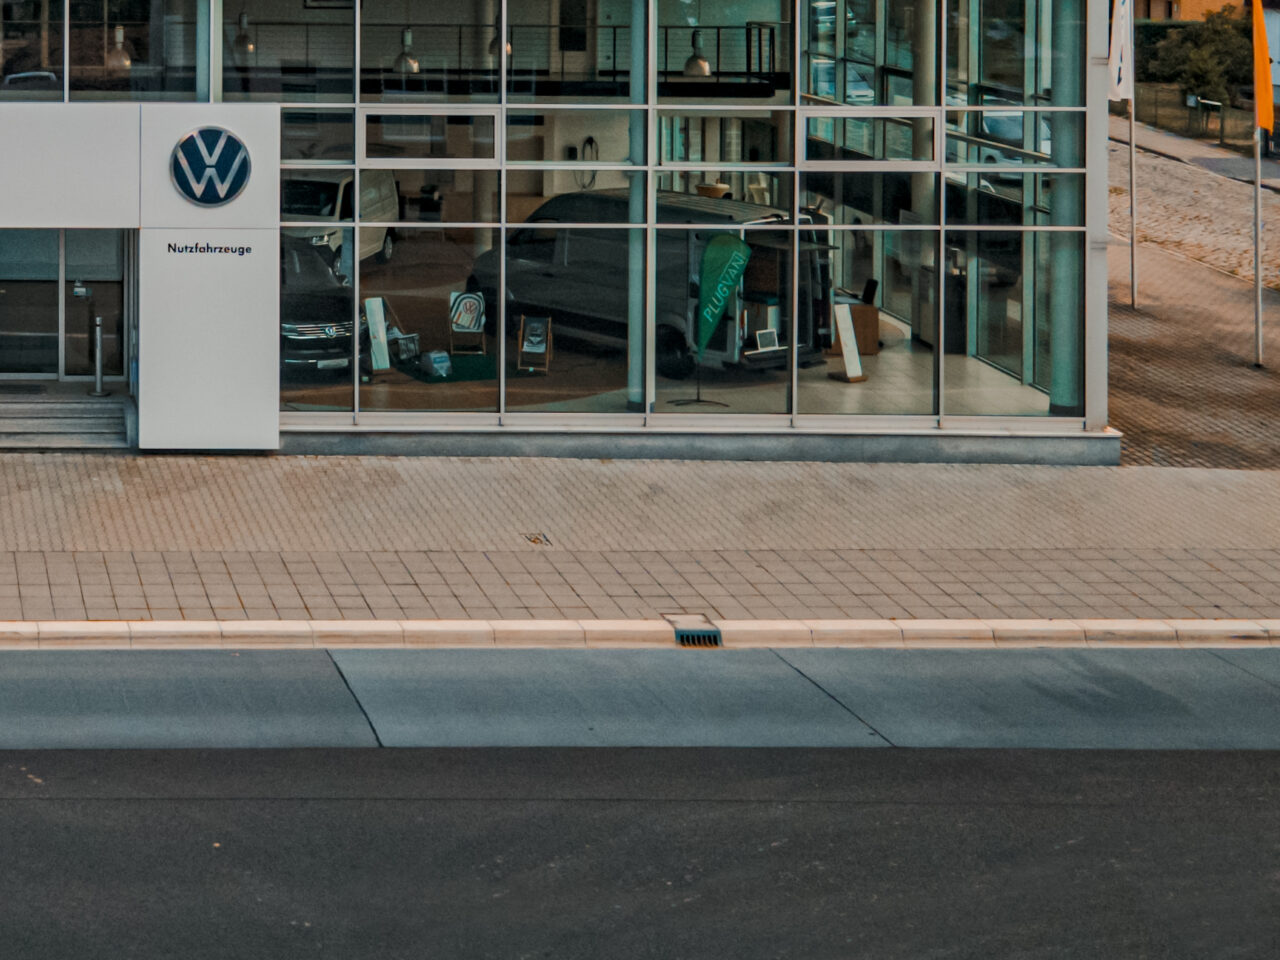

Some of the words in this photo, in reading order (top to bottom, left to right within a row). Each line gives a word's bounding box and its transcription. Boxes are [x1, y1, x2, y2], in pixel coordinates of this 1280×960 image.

[173, 128, 249, 201] VW
[167, 242, 252, 256] Nutzfahrzeuge
[703, 252, 745, 322] PLUGVAN
